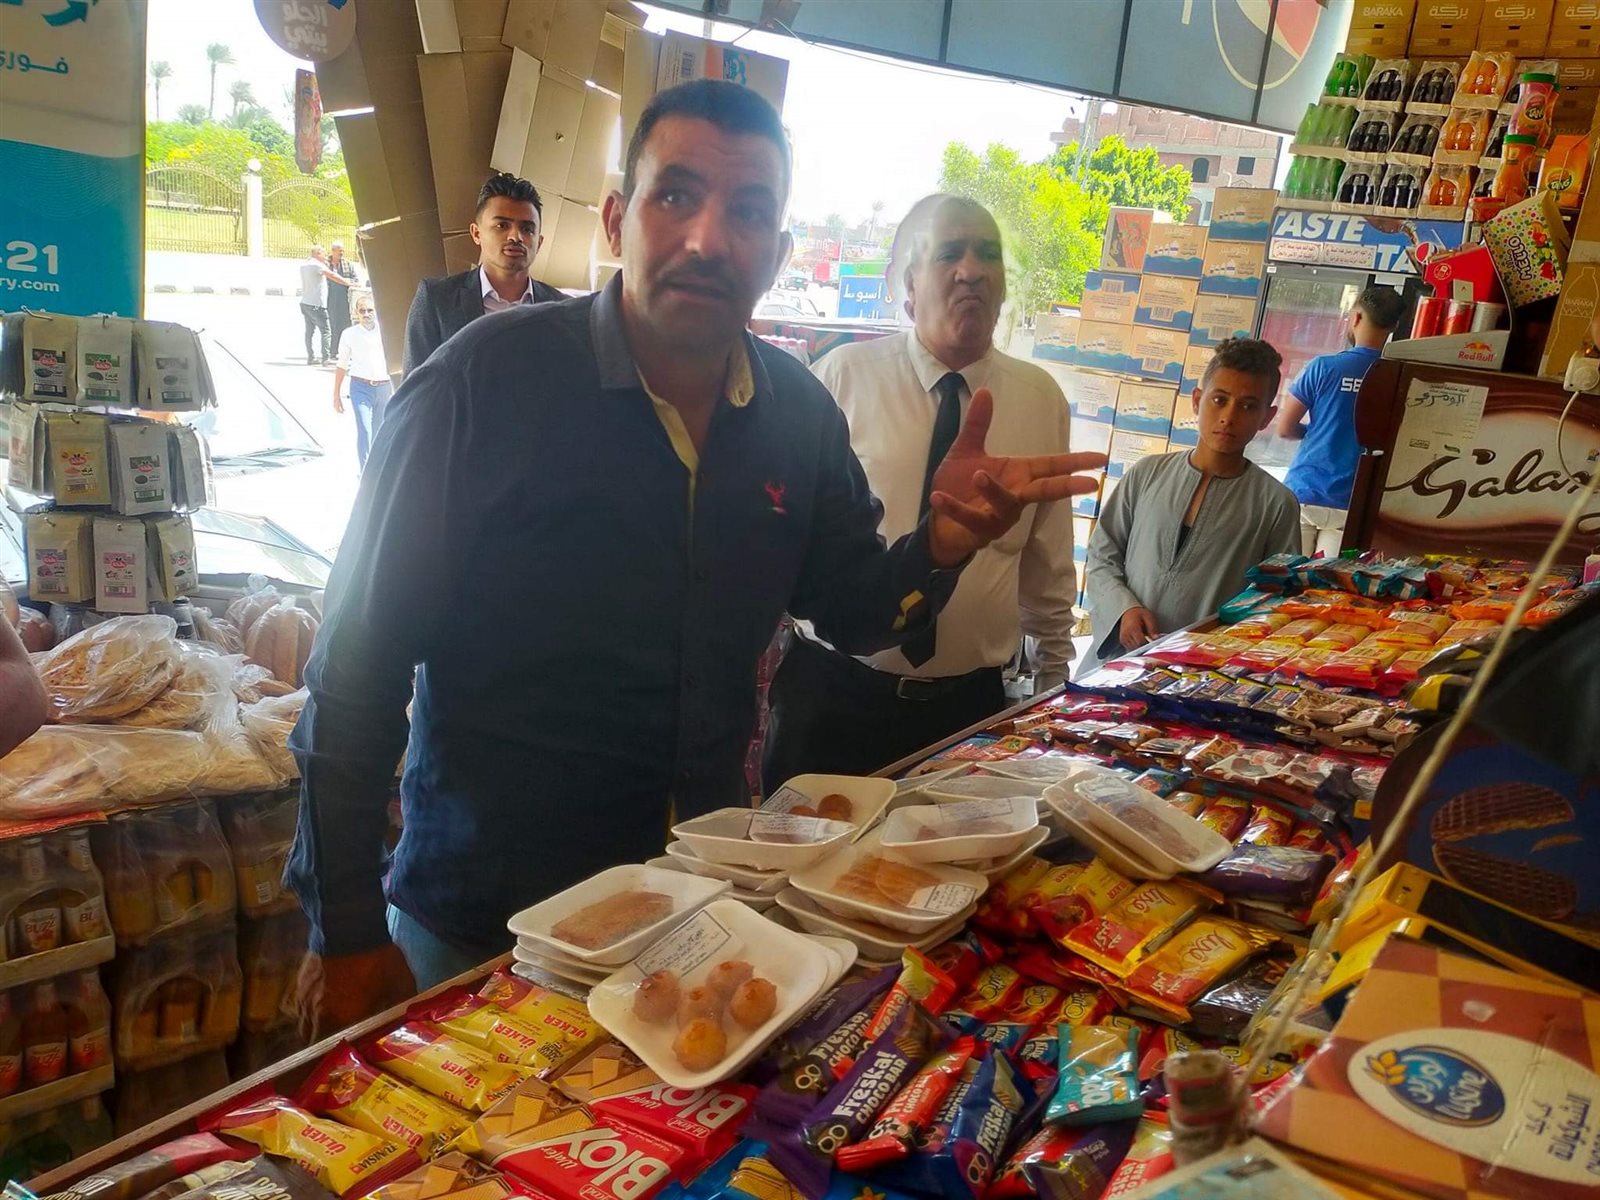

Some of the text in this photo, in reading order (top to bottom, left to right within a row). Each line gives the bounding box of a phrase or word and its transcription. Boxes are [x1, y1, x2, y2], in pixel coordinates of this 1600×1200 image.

[1363, 7, 1404, 17] BARAKA
[1428, 6, 1469, 20] بركة
[842, 282, 882, 303] أسيوط
[1458, 350, 1494, 362] Red Bull
[832, 1051, 897, 1118] Freska!
[856, 1080, 891, 1125] CHOCO
[884, 1057, 908, 1083] BAR
